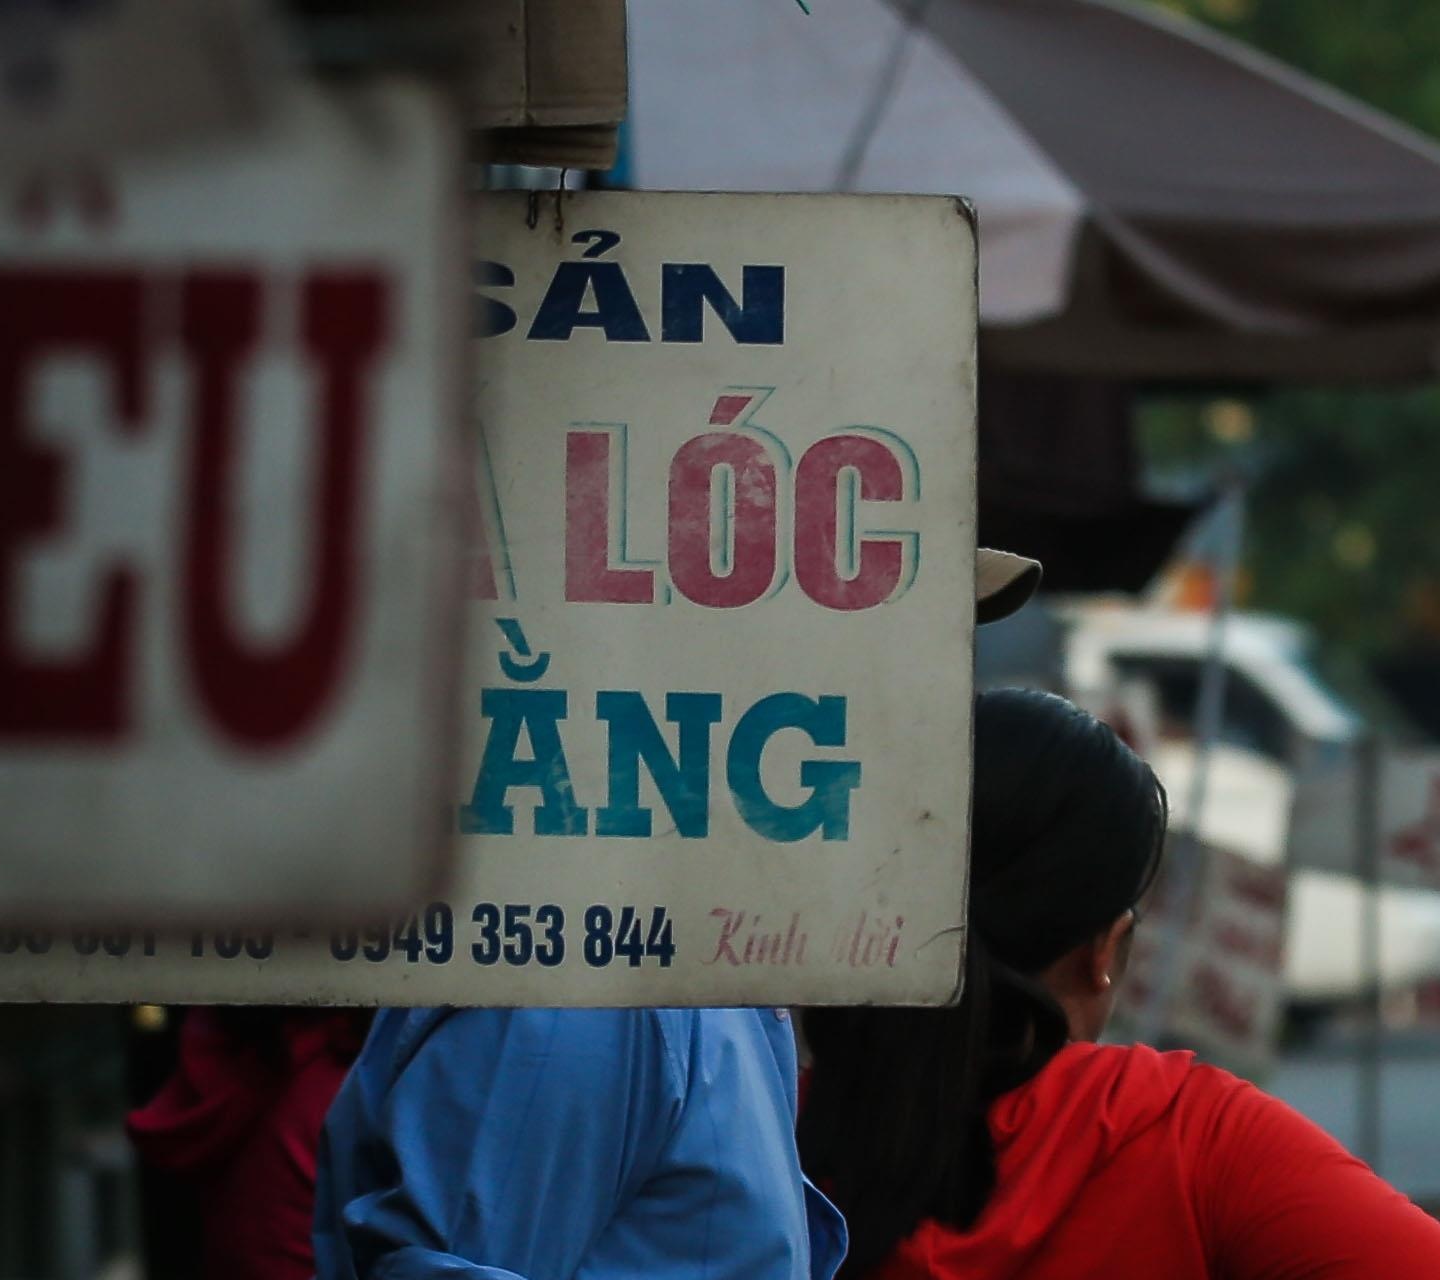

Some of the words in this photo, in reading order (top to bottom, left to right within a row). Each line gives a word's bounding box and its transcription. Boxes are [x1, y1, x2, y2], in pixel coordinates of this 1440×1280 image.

[564, 390, 916, 611] LÓC
[460, 618, 862, 843] ẰNG
[471, 903, 566, 967] 353
[583, 905, 677, 969] 844
